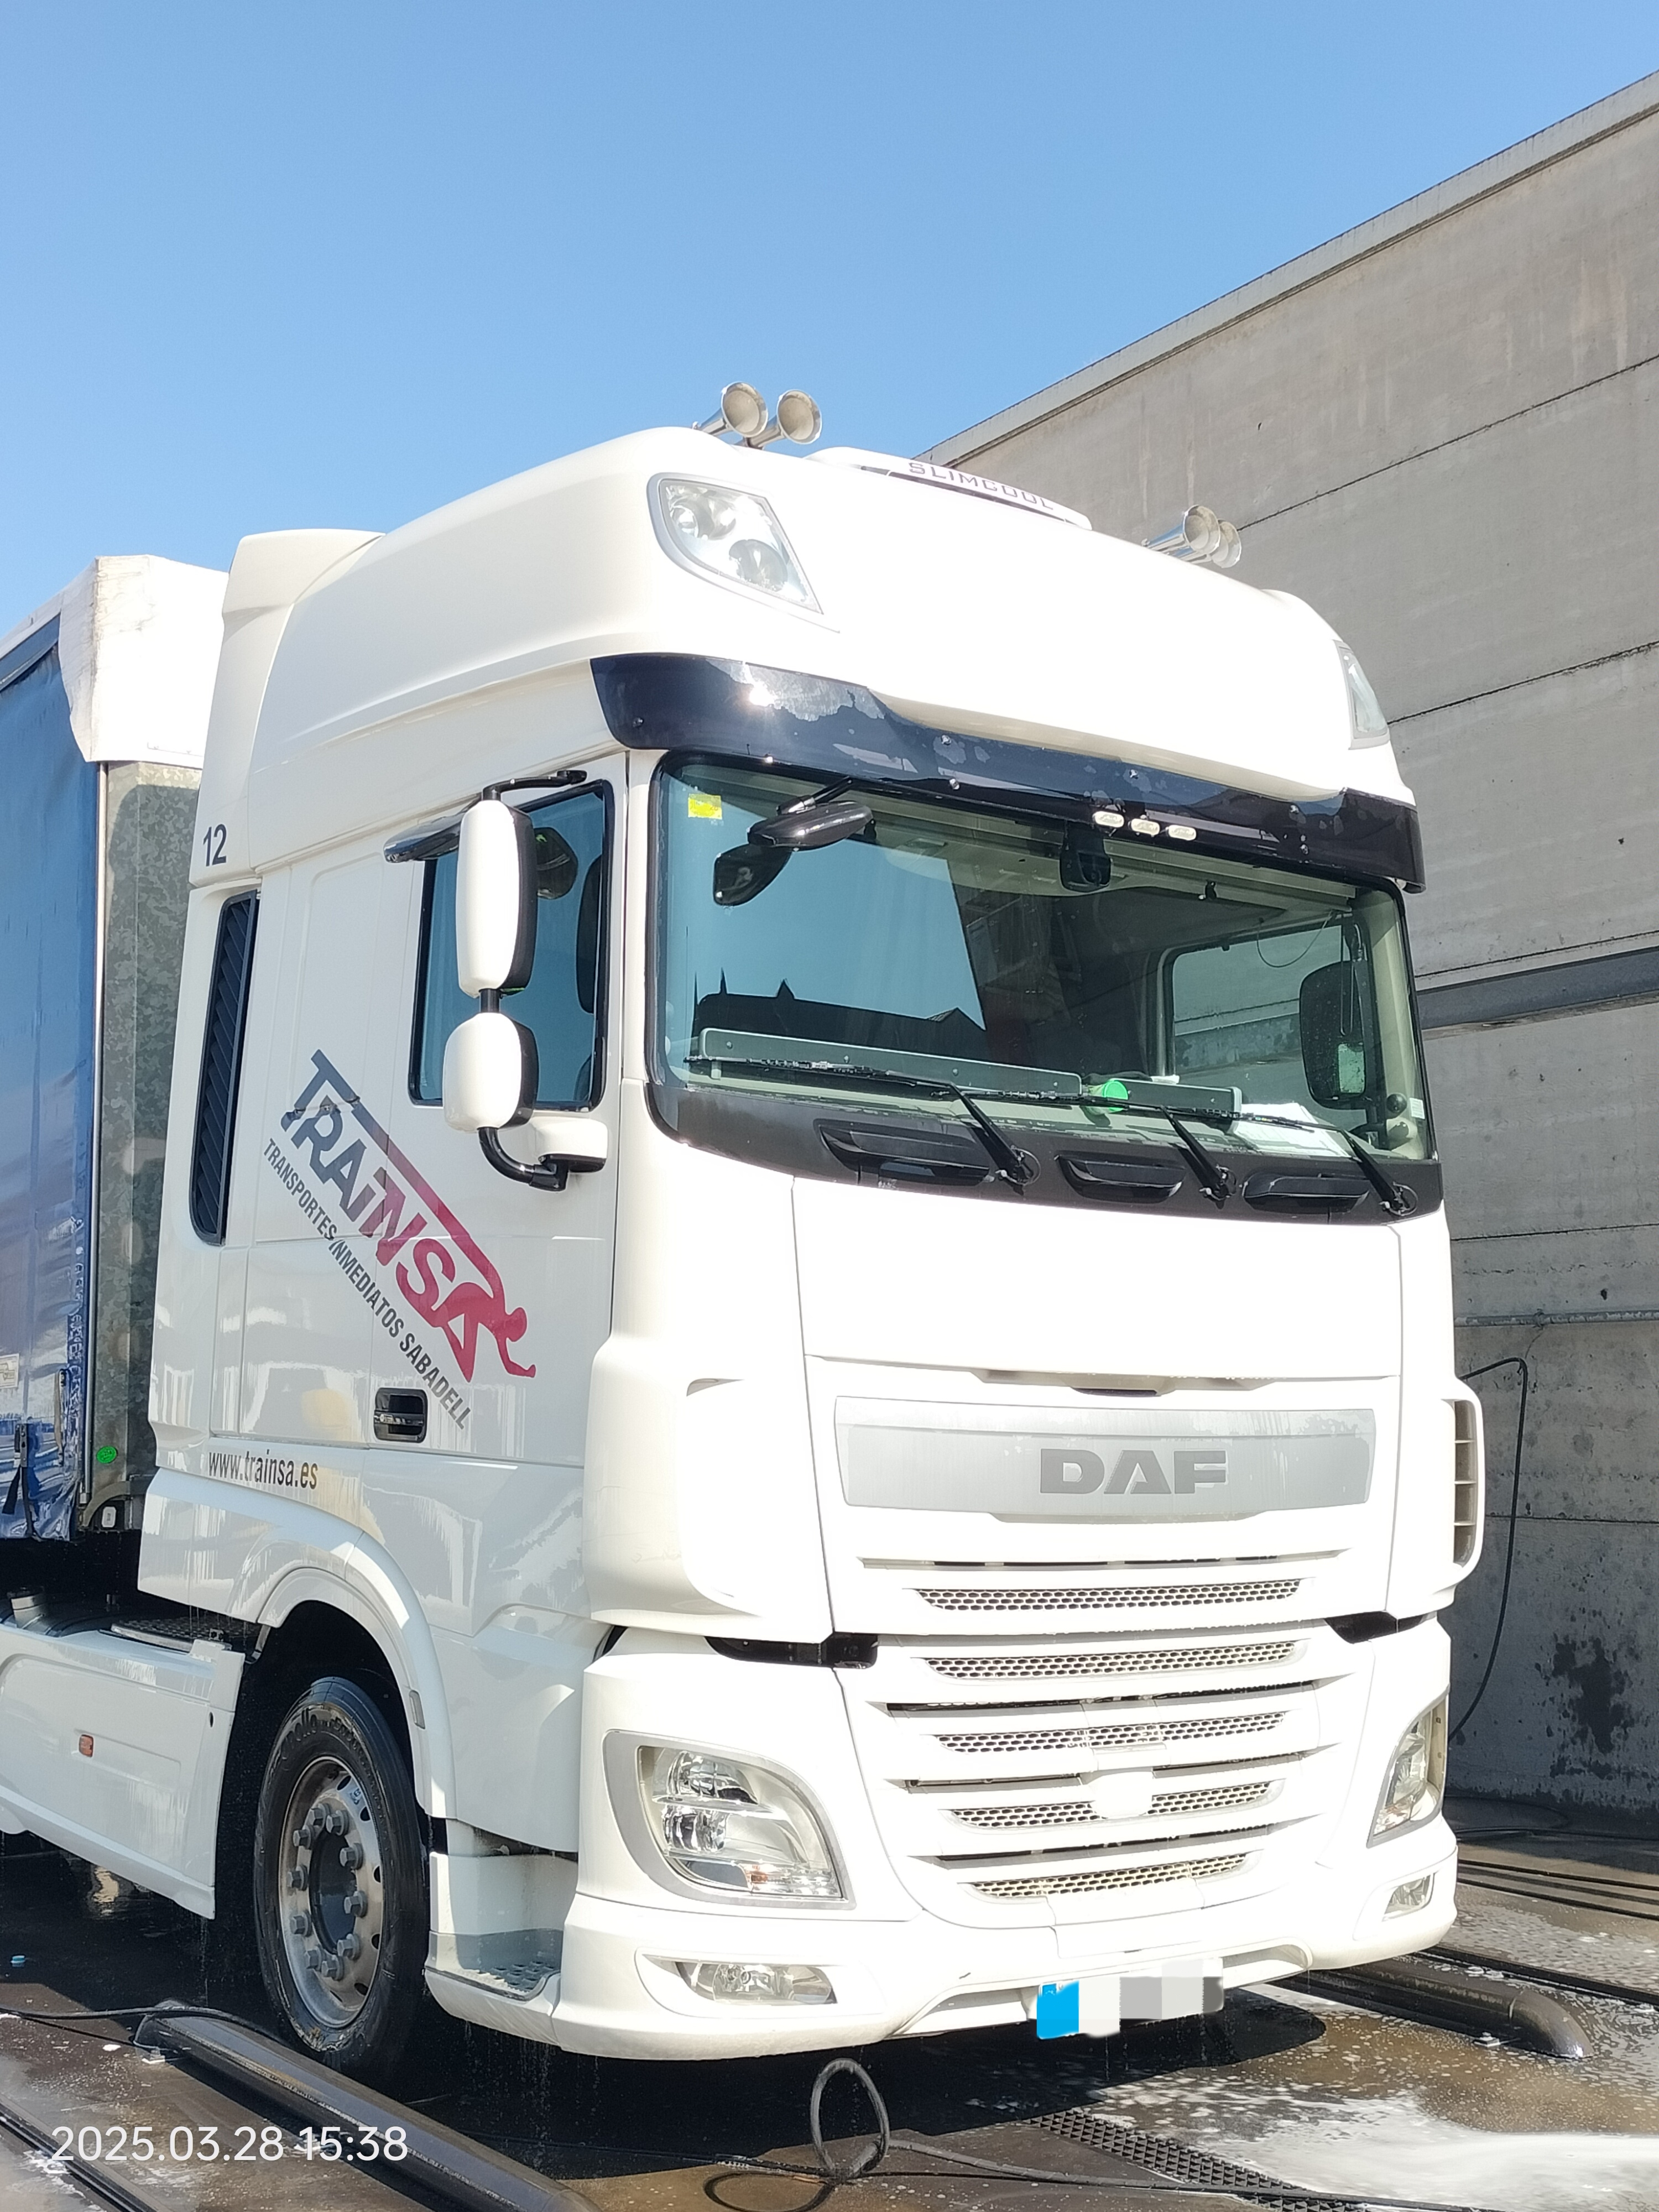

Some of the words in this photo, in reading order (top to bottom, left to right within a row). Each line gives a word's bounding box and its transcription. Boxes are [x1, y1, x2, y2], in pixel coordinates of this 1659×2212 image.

[909, 462, 1053, 510] SLIMCOOL
[202, 823, 227, 867] 12
[263, 1138, 337, 1241] TRANSPORTES
[328, 1239, 404, 1338] INMEDIATOS
[399, 1333, 471, 1436] SABADELL
[208, 1448, 319, 1490] www.trainsa.es
[1039, 1448, 1228, 1495] DAF
